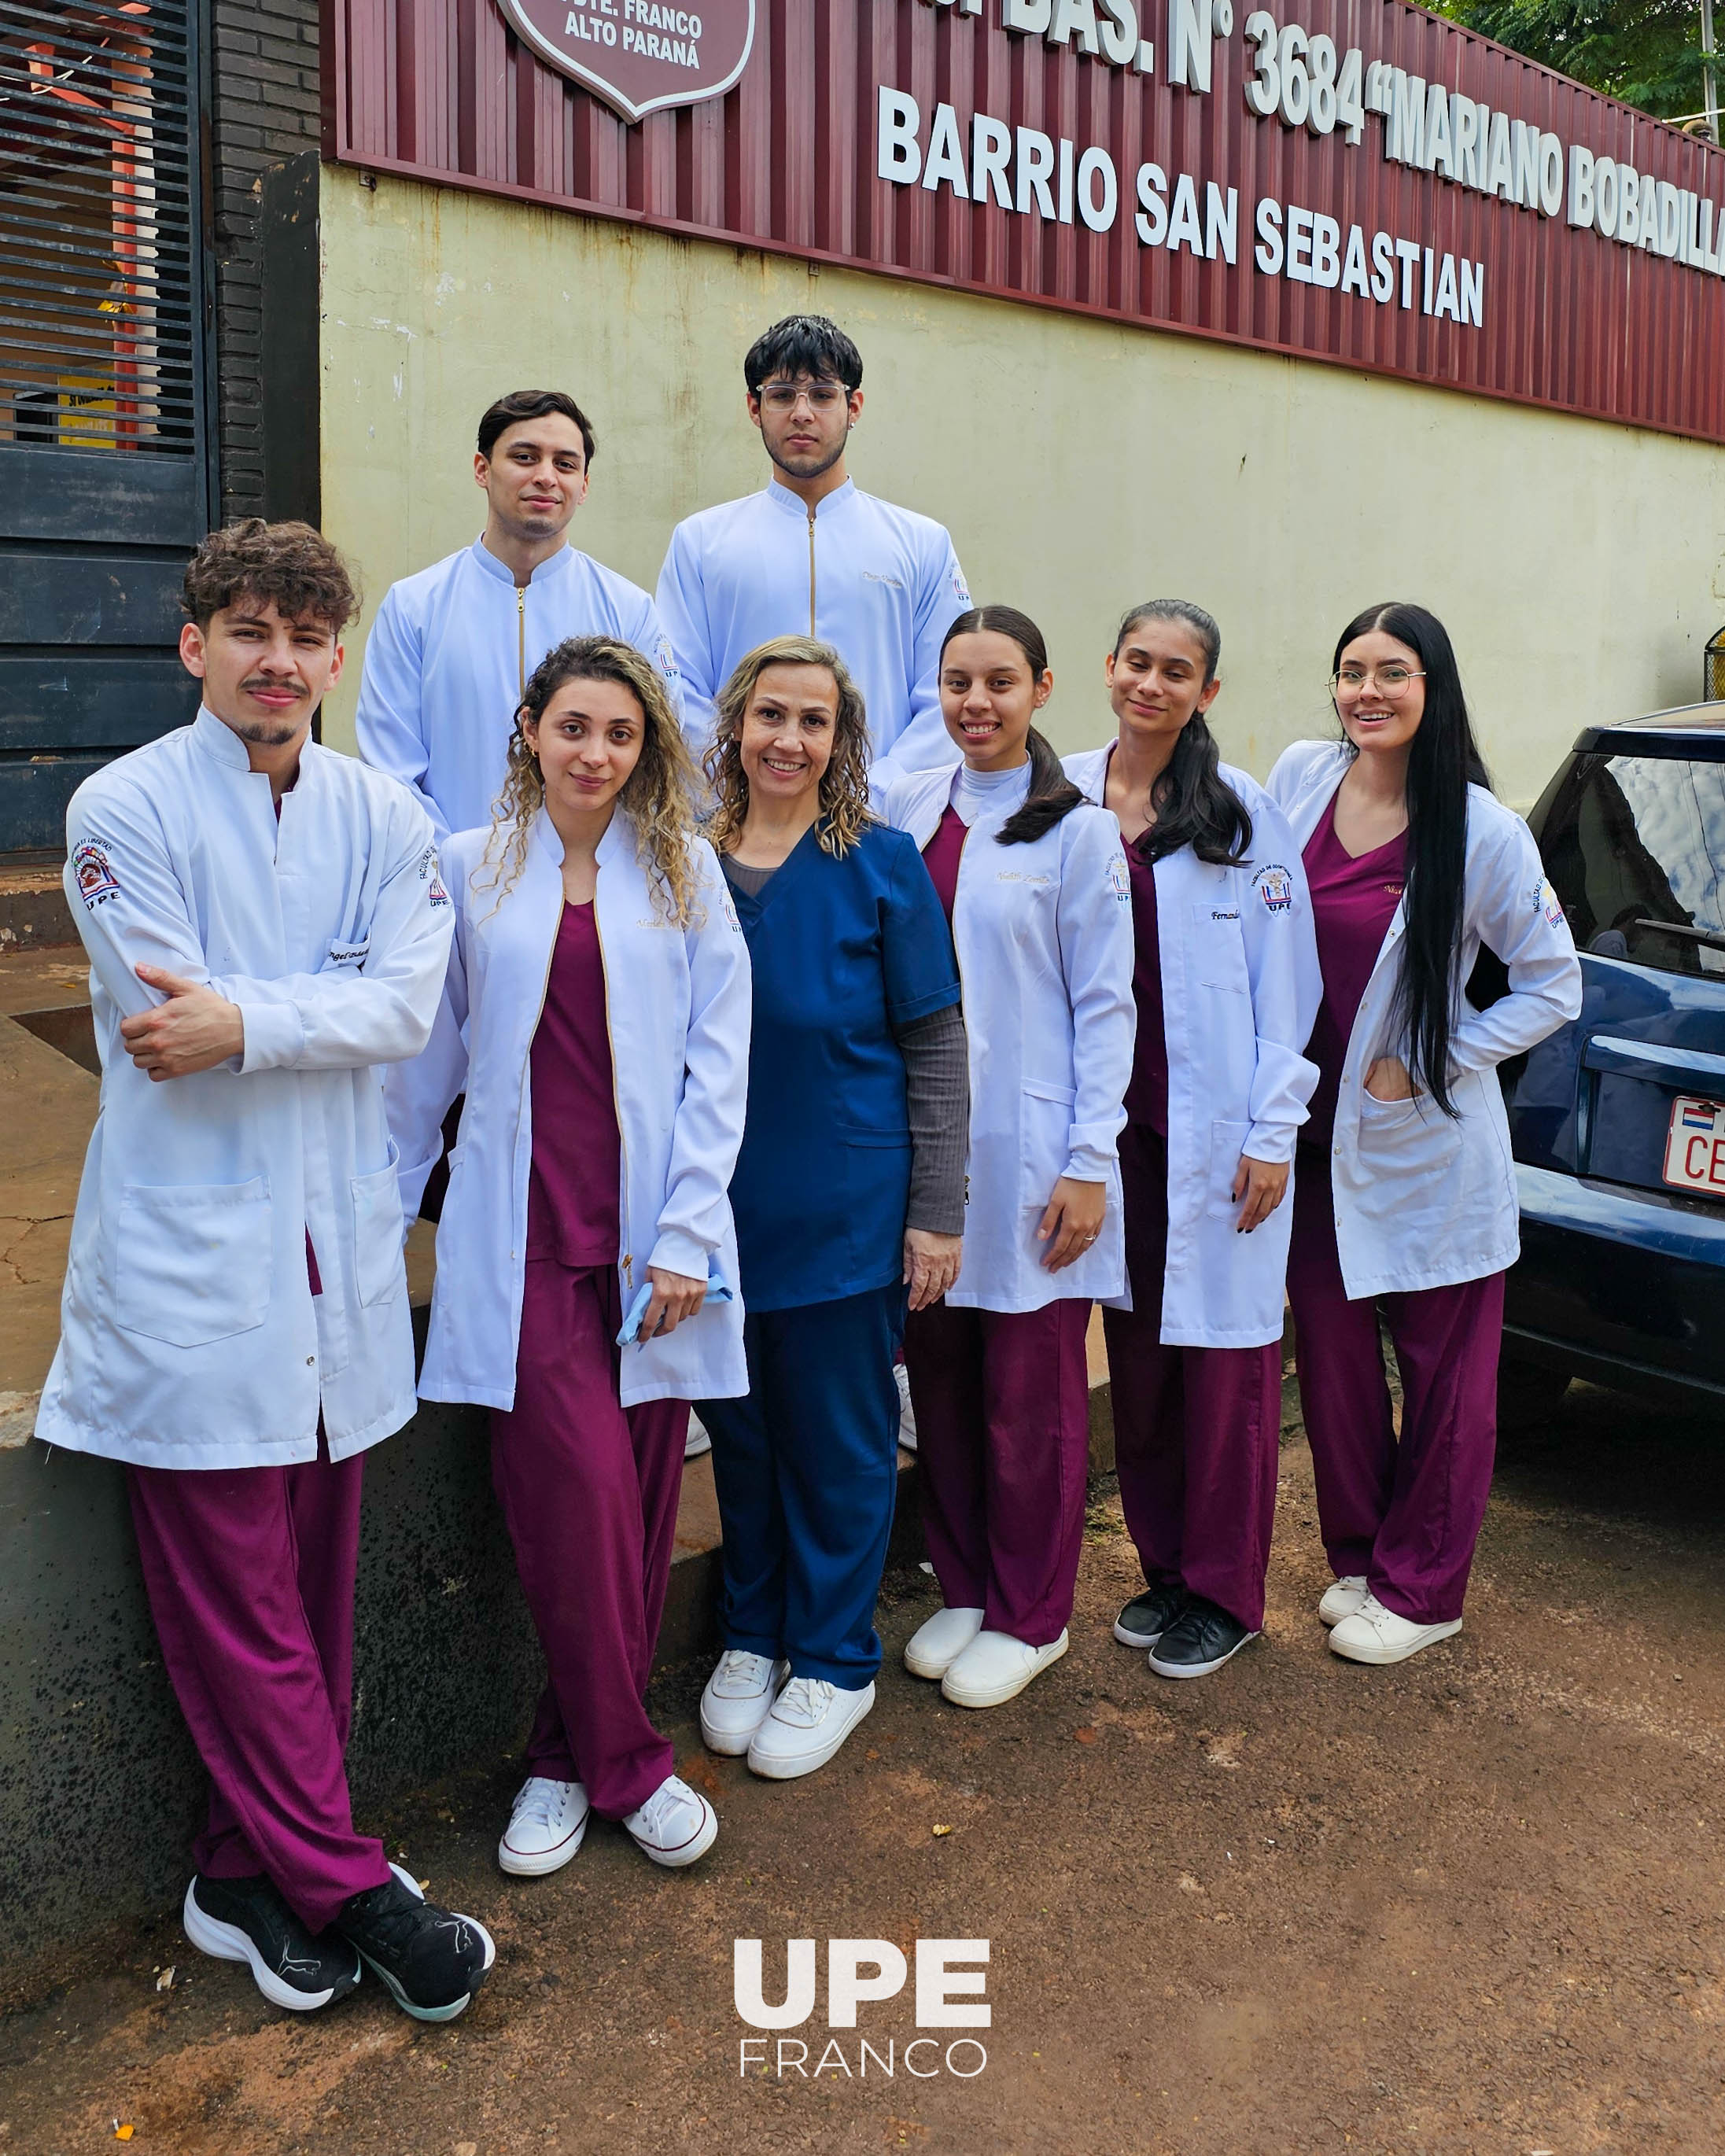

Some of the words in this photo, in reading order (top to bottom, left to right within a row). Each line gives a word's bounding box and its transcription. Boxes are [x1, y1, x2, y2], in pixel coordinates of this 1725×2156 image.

[625, 0, 702, 39] FRANCO
[565, 11, 617, 46] ALTO
[622, 39, 700, 70] PARANÁ
[1244, 10, 1365, 146] 3684
[878, 85, 1118, 233] BARRIO
[1134, 162, 1238, 264] SAN
[1255, 197, 1484, 328] SEBASTIAN
[419, 850, 433, 879] FACULTAD
[86, 891, 121, 911] UPE
[1268, 902, 1291, 912] UPE
